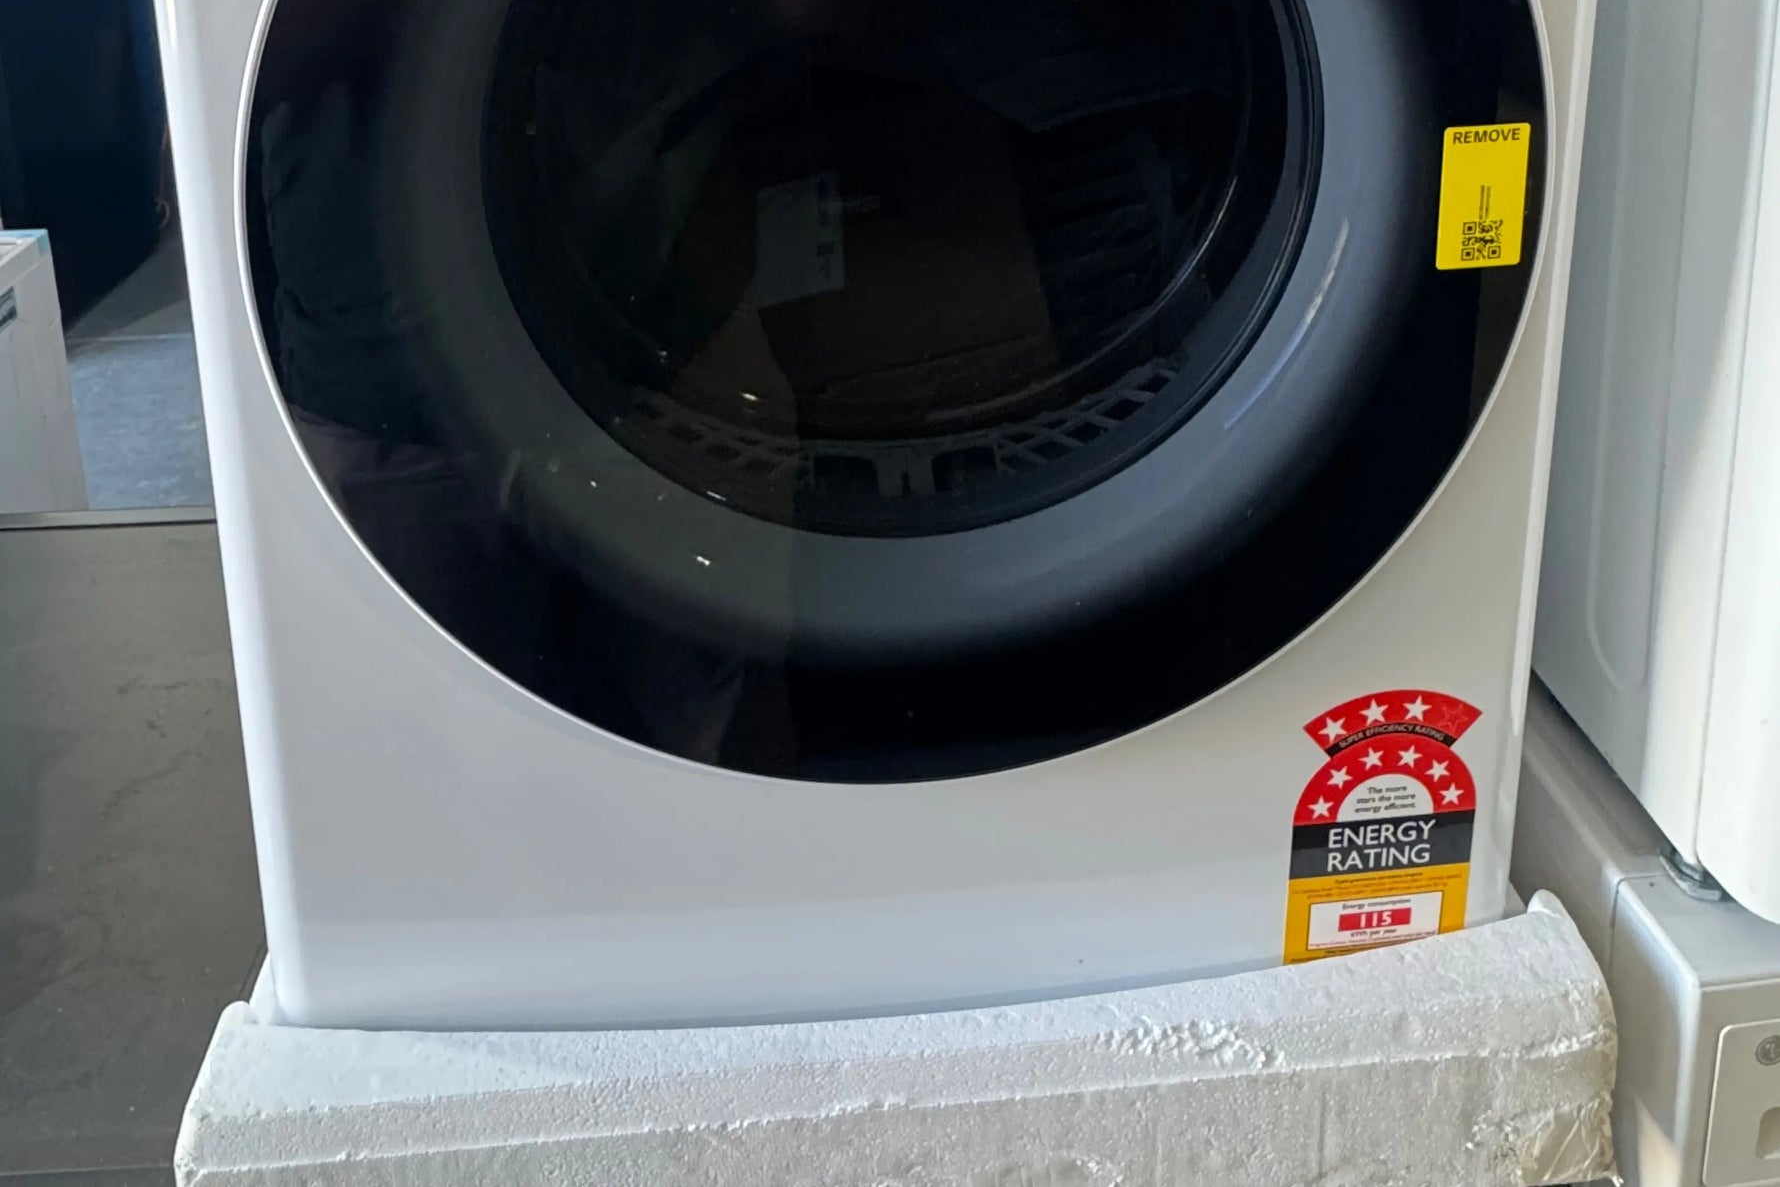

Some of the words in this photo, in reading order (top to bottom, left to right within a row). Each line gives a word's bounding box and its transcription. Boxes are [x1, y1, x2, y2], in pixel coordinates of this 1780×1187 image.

[1453, 128, 1521, 145] REMOVE
[1338, 729, 1365, 749] SUPER
[1365, 723, 1414, 737] EFFICIENCY
[1414, 724, 1445, 742] RATING
[1368, 786, 1382, 794] The
[1356, 796, 1376, 805] stars
[1378, 795, 1392, 803] the
[1394, 793, 1416, 802] more
[1354, 804, 1382, 814] energy
[1328, 818, 1437, 849] ENERGY
[1326, 843, 1431, 873] RATING
[1342, 902, 1366, 911] Energy
[1359, 910, 1392, 929] 115
